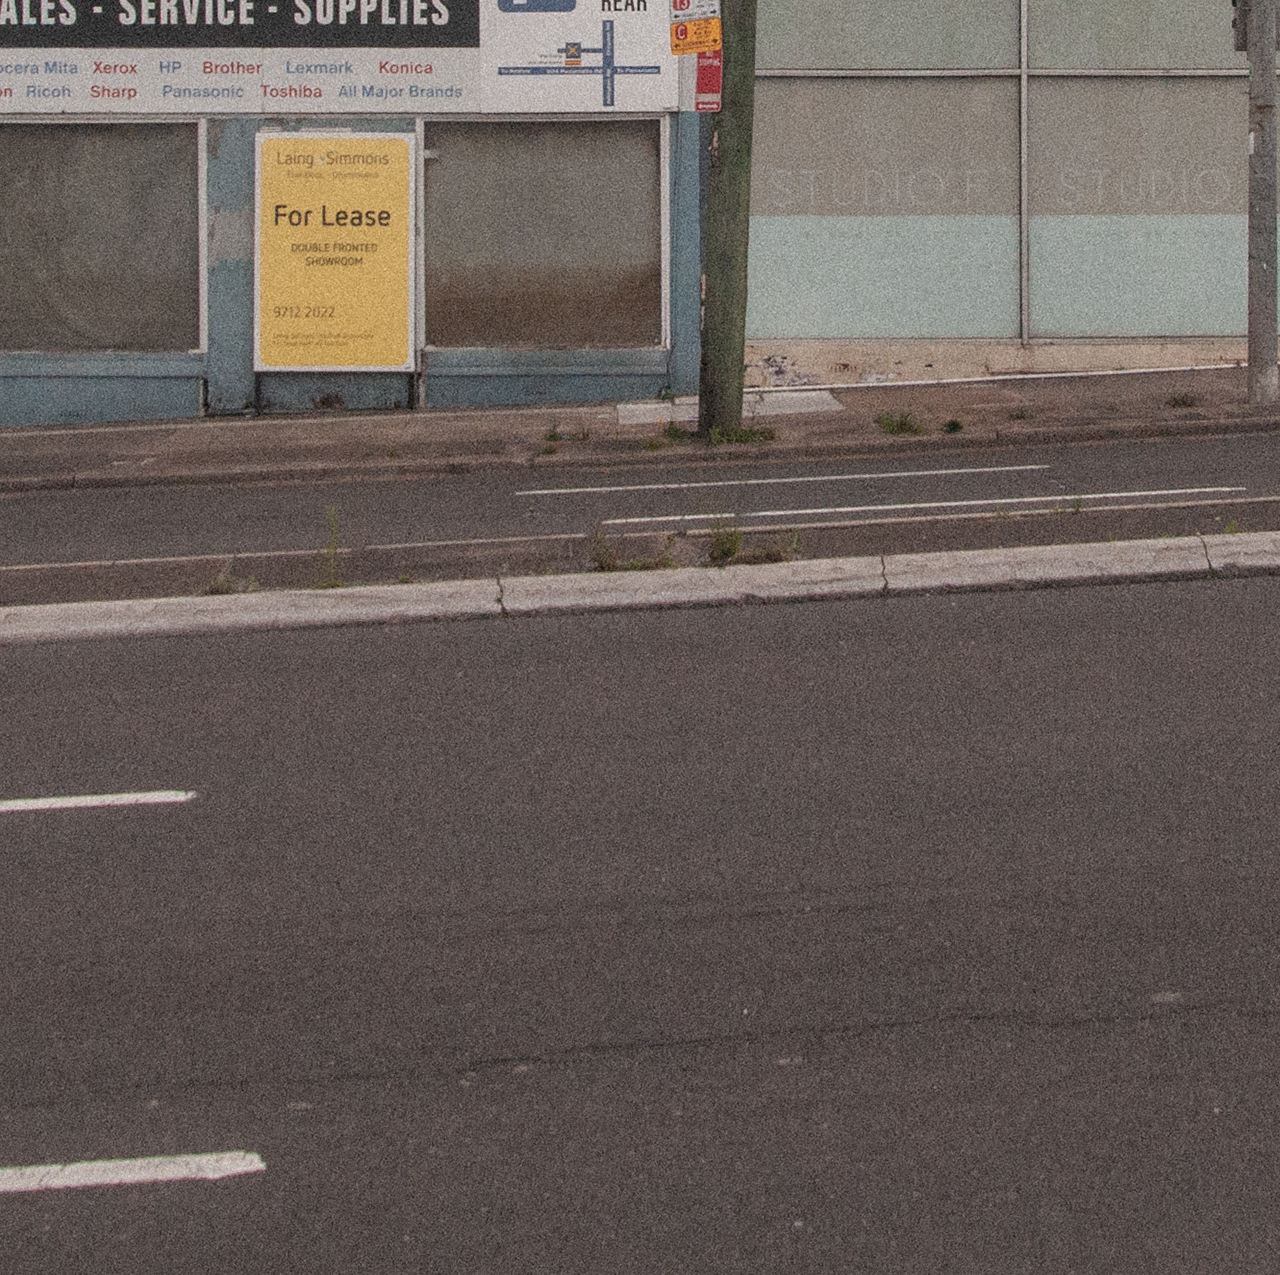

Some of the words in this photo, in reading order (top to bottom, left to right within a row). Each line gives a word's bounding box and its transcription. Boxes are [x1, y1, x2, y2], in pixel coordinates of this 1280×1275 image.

[44, 61, 78, 74] Mita
[93, 61, 138, 74] Xerox
[159, 61, 182, 74] HP
[202, 61, 262, 75] Brother
[286, 61, 354, 74] Lexmark
[379, 61, 433, 75] Konica
[26, 85, 71, 98] Ricoh
[90, 85, 137, 100] Sharp
[162, 85, 244, 98] Panasonic
[261, 85, 322, 98] Toshiba
[338, 85, 357, 98] All
[362, 85, 403, 101] Major
[409, 85, 463, 98] Brands
[276, 152, 313, 168] Laing
[326, 151, 389, 165] Simmons
[274, 205, 313, 226] For
[322, 205, 391, 226] Lease
[291, 243, 330, 253] DOUBLE
[333, 243, 378, 253] FRONTED
[305, 257, 363, 267] SHOWROOM
[273, 306, 301, 318] 9712
[305, 306, 335, 318] 2022
